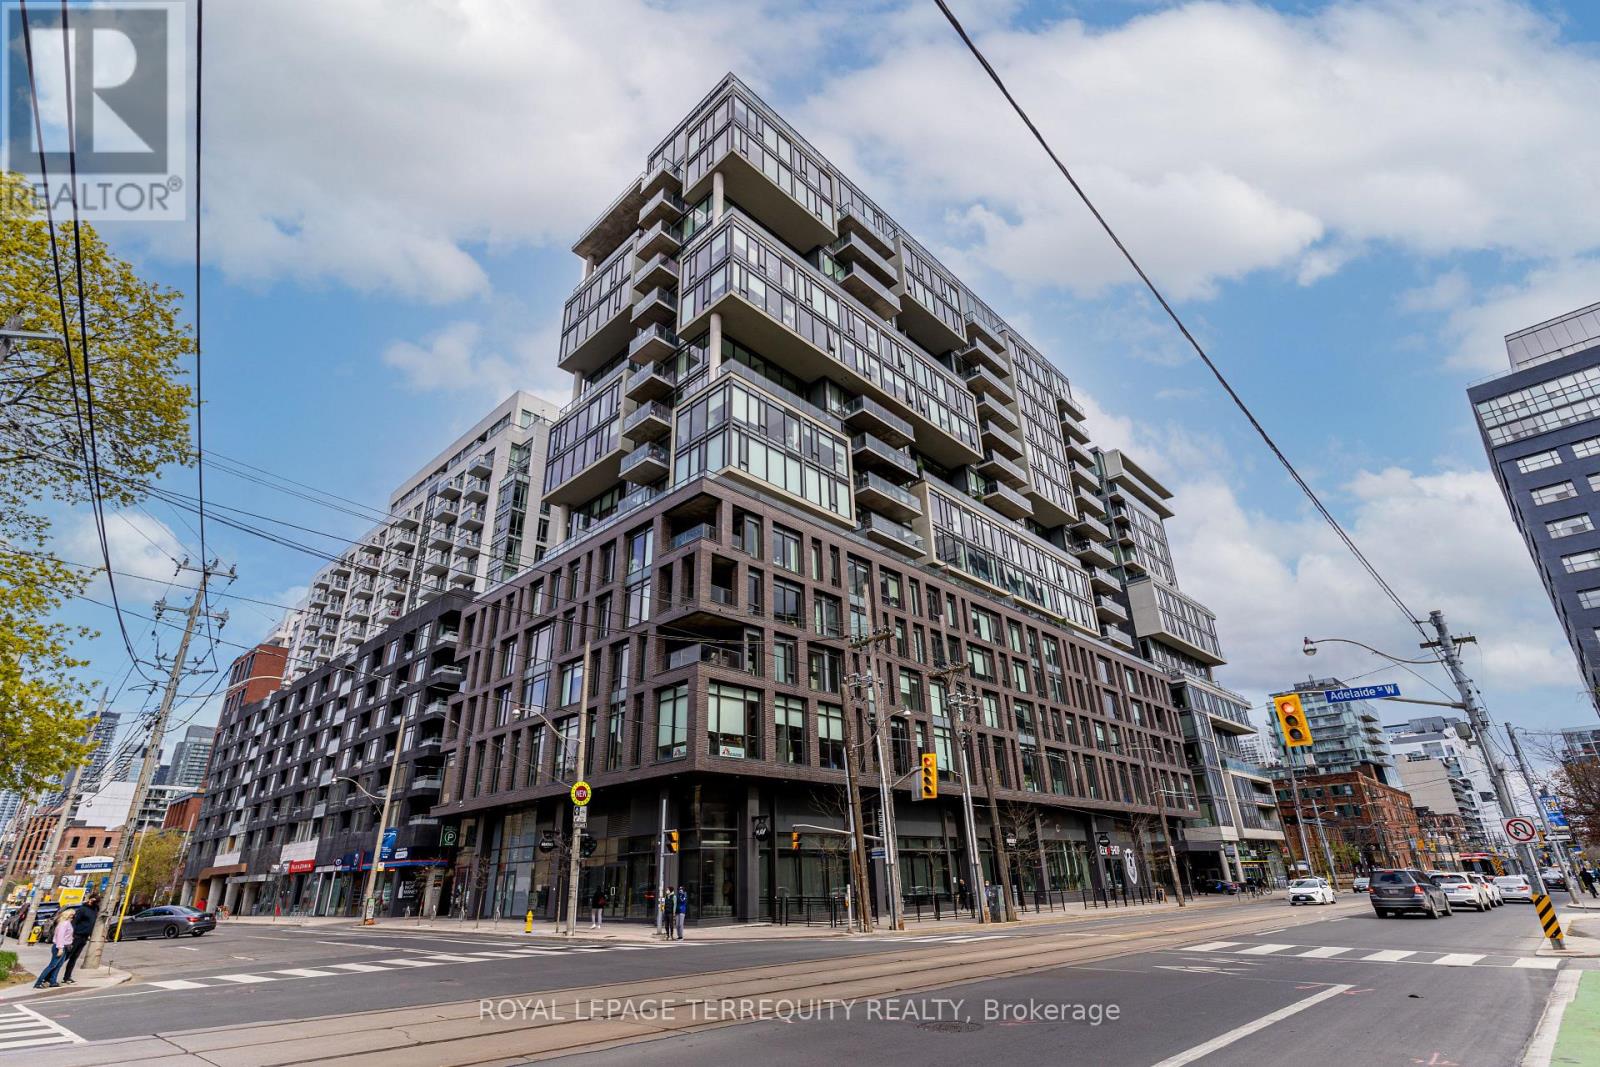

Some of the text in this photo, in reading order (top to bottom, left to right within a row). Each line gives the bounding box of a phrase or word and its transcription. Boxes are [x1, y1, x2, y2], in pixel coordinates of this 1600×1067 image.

[1330, 688, 1376, 700] Adelaide
[1384, 685, 1395, 694] W
[576, 790, 586, 798] NEW
